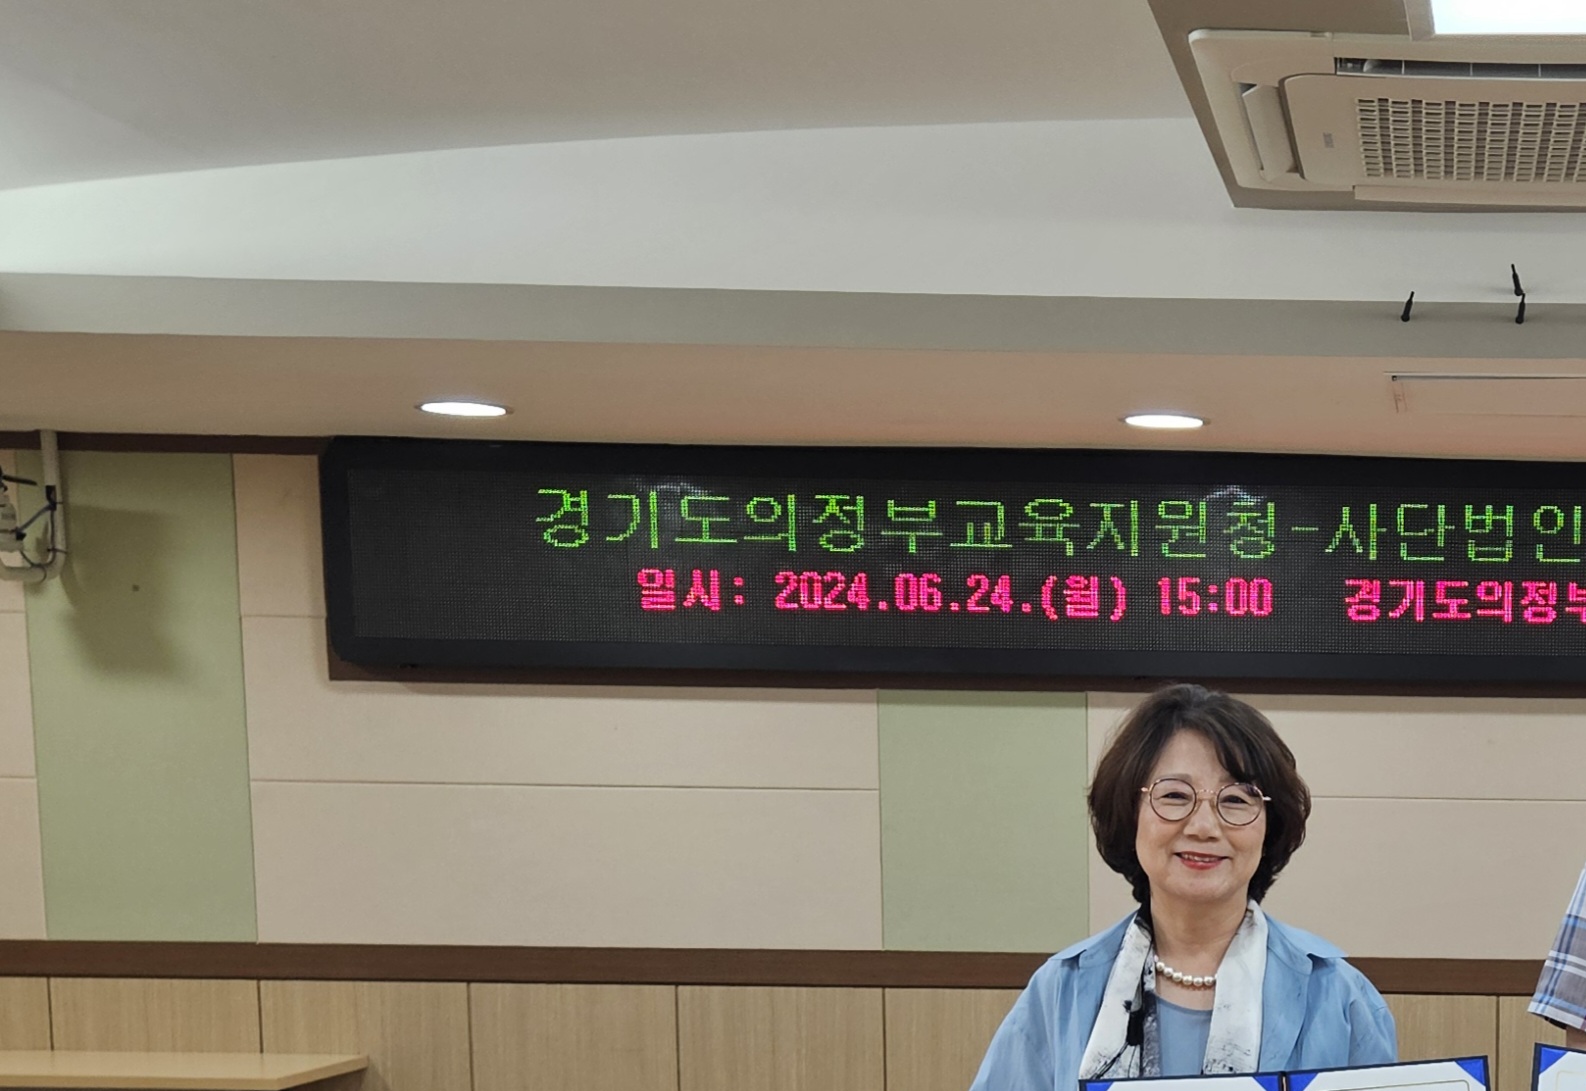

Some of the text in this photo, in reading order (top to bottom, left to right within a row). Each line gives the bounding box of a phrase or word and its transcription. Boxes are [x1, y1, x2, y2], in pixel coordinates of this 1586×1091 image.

[636, 567, 745, 612] 일시:
[774, 571, 1127, 622] 2024.06.24.(월)
[1157, 576, 1274, 617] 15:00
